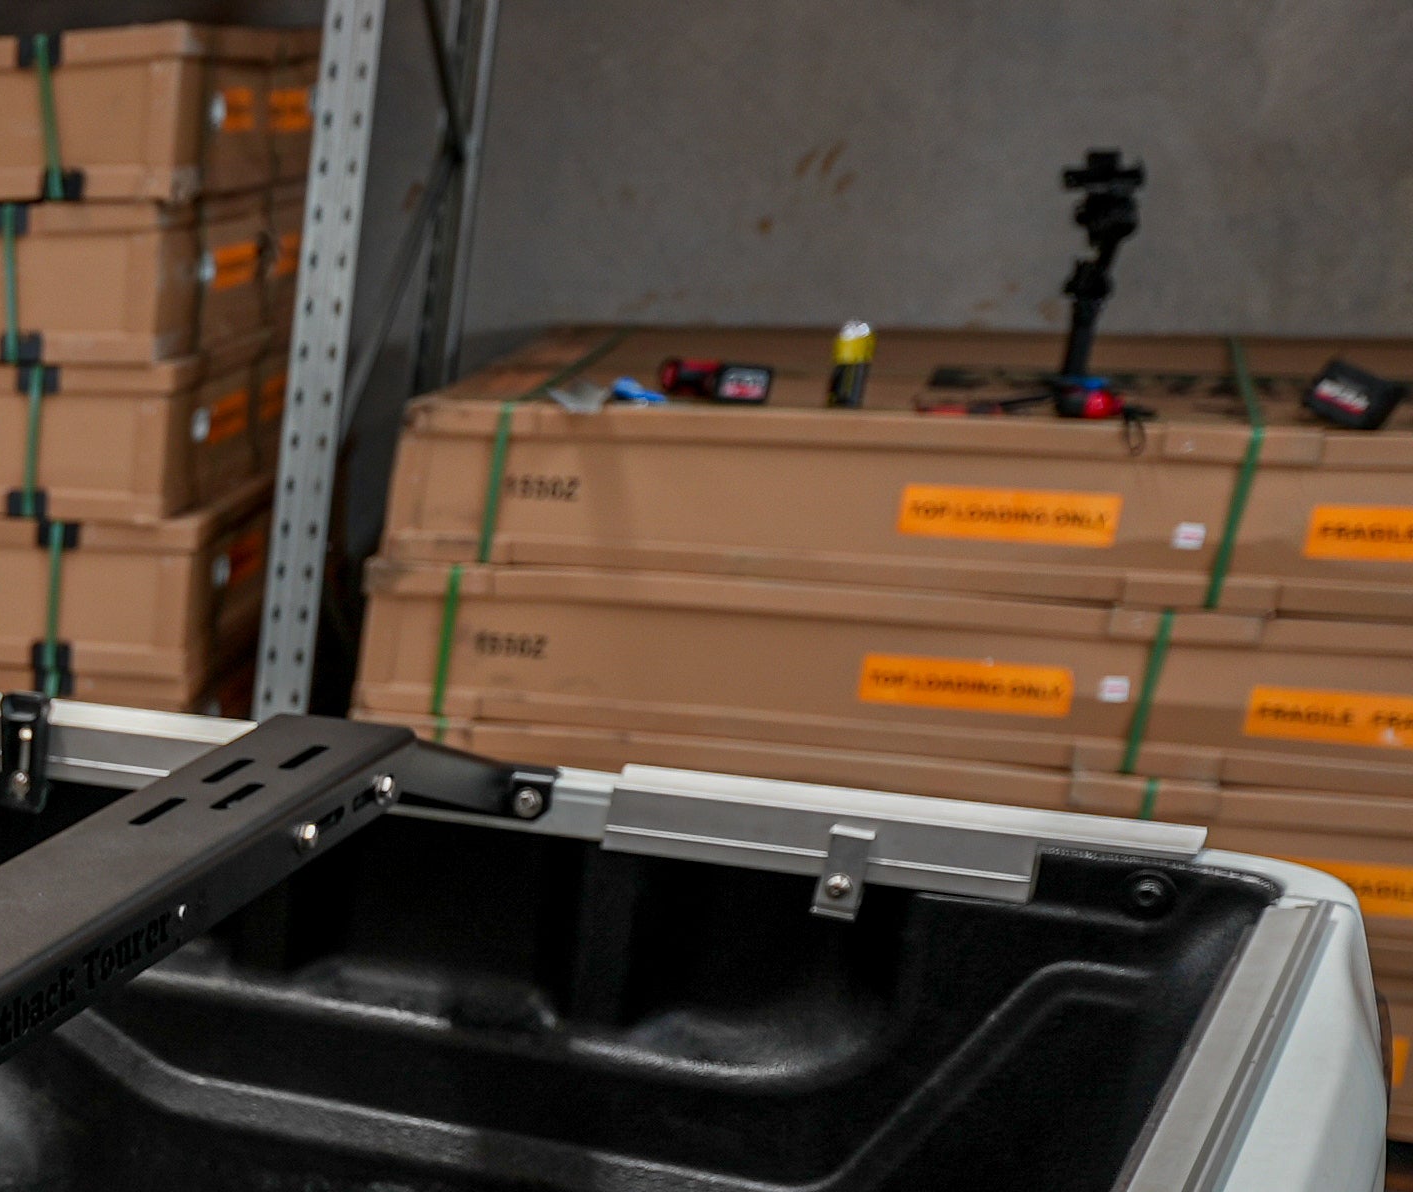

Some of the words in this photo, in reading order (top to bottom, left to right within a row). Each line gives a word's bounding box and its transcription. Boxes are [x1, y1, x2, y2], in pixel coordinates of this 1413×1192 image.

[910, 501, 950, 521] TOP
[954, 503, 1049, 527] LOADING
[1051, 507, 1109, 532] ONLY
[869, 669, 907, 690] TOP
[911, 671, 1007, 698] LOADING
[1010, 680, 1064, 702] ONLY
[1256, 703, 1355, 728] FRAGILE
[82, 909, 173, 991] Tourer
